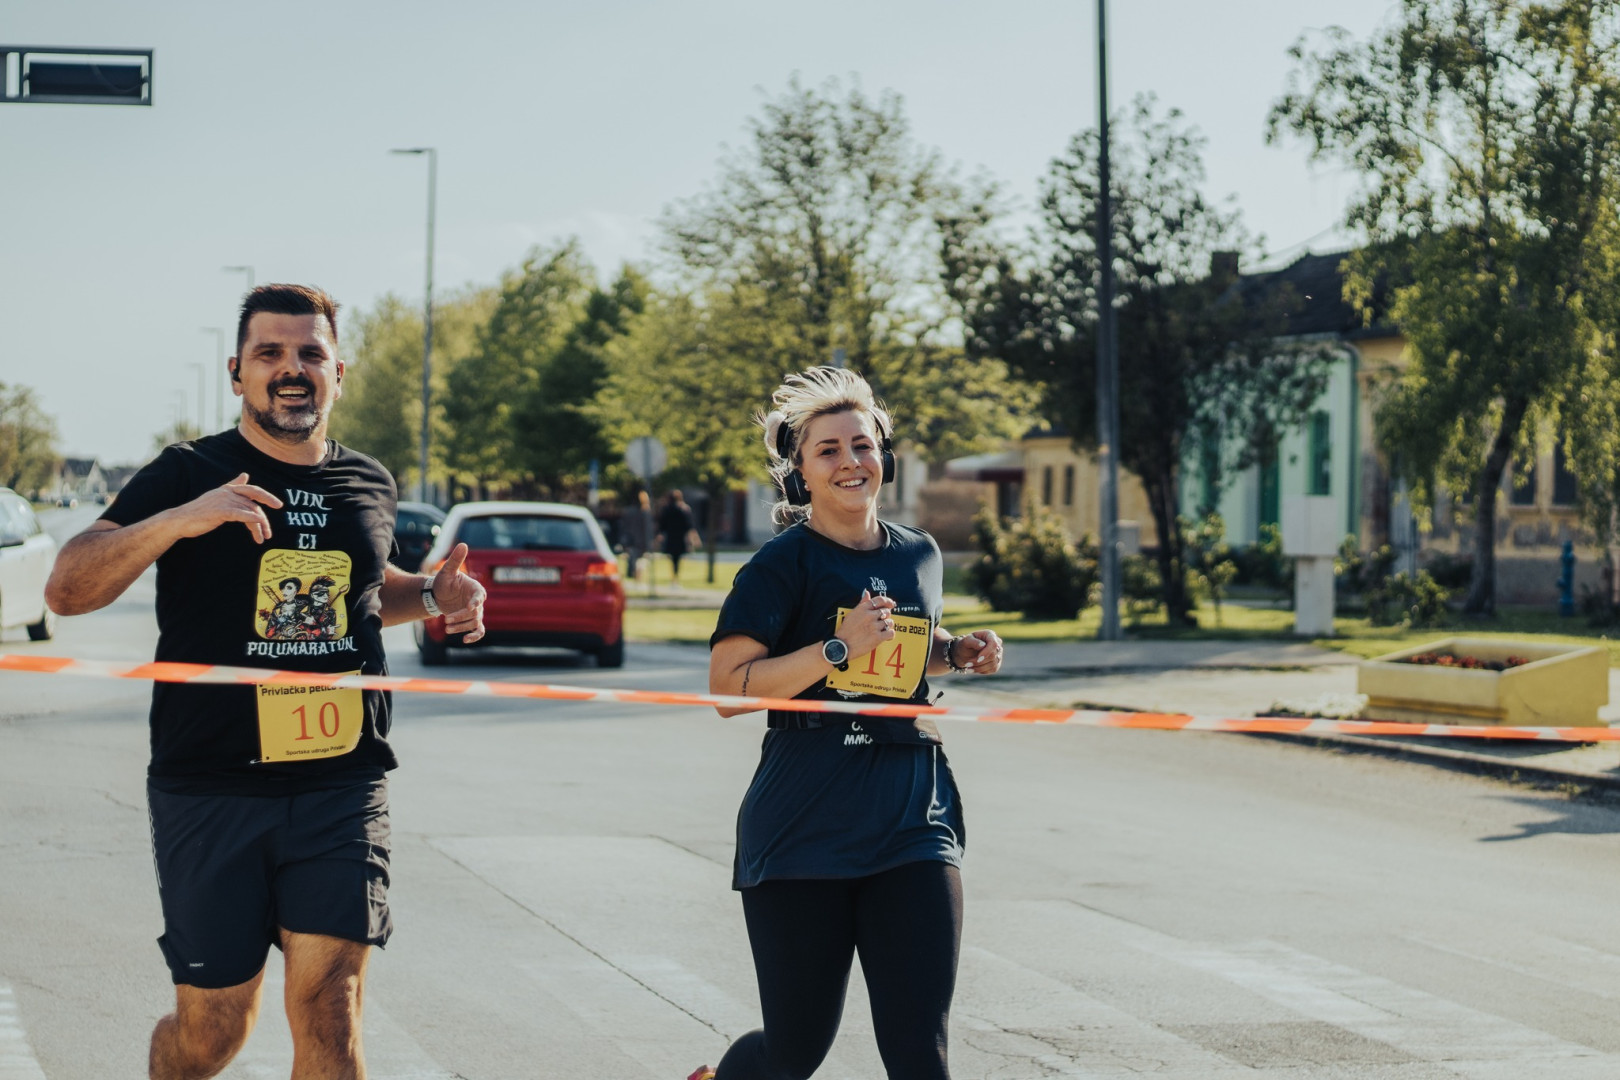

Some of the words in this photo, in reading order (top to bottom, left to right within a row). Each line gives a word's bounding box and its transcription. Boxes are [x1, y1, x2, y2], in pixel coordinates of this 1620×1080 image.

[286, 488, 333, 510] VIN
[287, 511, 328, 528] KOV
[298, 533, 317, 550] CI
[247, 636, 359, 659] POLUMARATON
[861, 642, 905, 679] 14
[261, 685, 306, 696] Privlačka
[291, 701, 340, 741] 10
